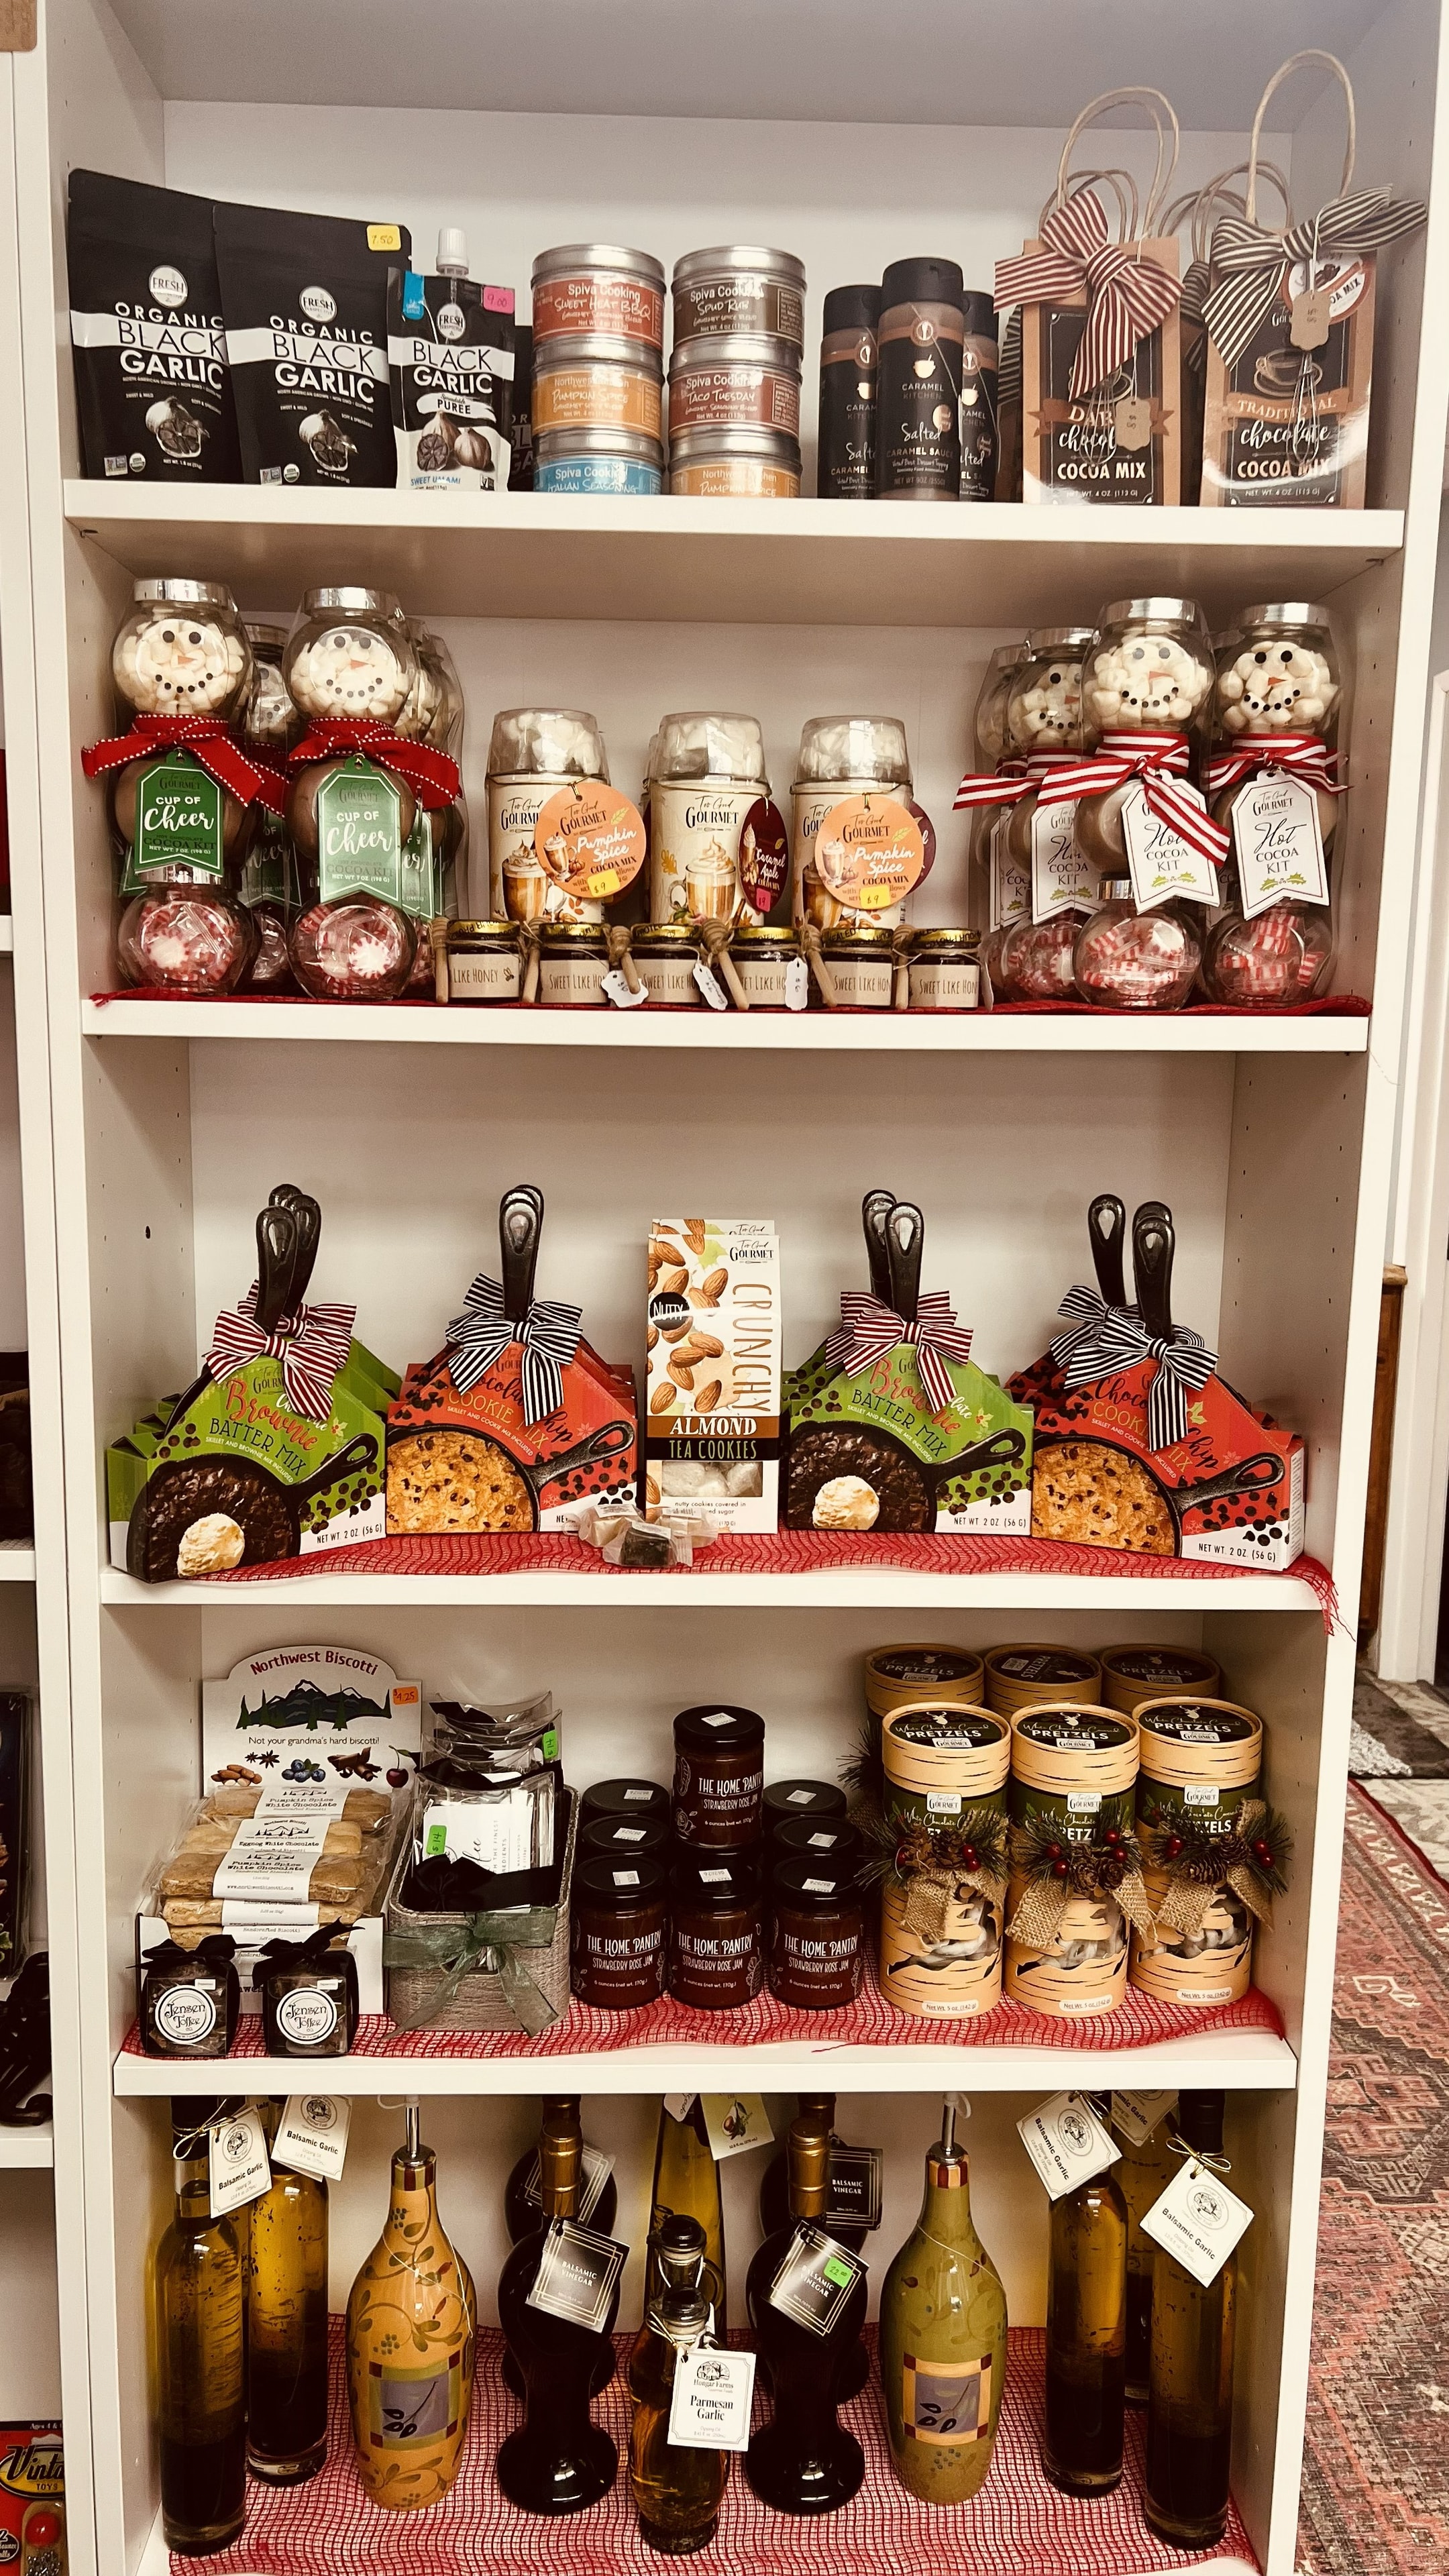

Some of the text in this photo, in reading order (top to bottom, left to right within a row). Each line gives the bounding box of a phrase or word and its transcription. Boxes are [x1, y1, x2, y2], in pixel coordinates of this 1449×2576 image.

[568, 283, 640, 302] Spiva Cooking
[690, 289, 714, 303] Spiva
[303, 297, 333, 311] FRESH
[621, 301, 650, 320] BBQ
[115, 302, 224, 329] ORGANIC
[439, 315, 463, 327] FRESH
[270, 316, 373, 344] ORGANIC
[118, 320, 227, 362] BLACK
[273, 333, 374, 376] BLACK
[413, 340, 492, 371] BLACK
[120, 350, 223, 389] GARLIC
[275, 363, 374, 403] GARLIC
[413, 366, 492, 394] GARLIC
[687, 376, 710, 390] Spiva
[902, 383, 944, 391] CARAMEL
[687, 389, 755, 405] TACO TUESDAY
[437, 400, 471, 415] PUREE
[1068, 405, 1113, 427] DAR
[1238, 398, 1336, 419] TRADITIOAL
[902, 422, 942, 441] Salted
[1240, 418, 1330, 449] chocolate
[886, 447, 954, 458] CARAMEL SAUCE
[1057, 462, 1146, 479] COCOA MIX
[1238, 460, 1291, 478] COCOA
[411, 476, 430, 486] SWEET
[160, 777, 201, 790] GOURMET
[156, 796, 201, 805] CUP OF
[1253, 798, 1293, 816] GOURMET
[144, 805, 214, 831] Cheer
[337, 811, 379, 822] CUP OF
[560, 810, 607, 835] GOURMET
[686, 806, 739, 828] GOURMET
[327, 822, 392, 856] Cheer
[578, 826, 637, 853] Pumpkin
[843, 824, 890, 843] GOURMET
[1254, 818, 1307, 854] Hot
[593, 845, 629, 865] Spice
[756, 847, 786, 867] Caramel
[854, 843, 915, 863] Pumpkin
[1146, 849, 1189, 860] COCOA
[1256, 847, 1299, 863] COCOA
[590, 855, 637, 873] COCOA MIX
[760, 863, 779, 879] Apple
[867, 862, 905, 879] Spice
[1158, 860, 1180, 871] KIT
[1267, 861, 1290, 874] KIT
[863, 877, 892, 885] COCOA
[453, 969, 499, 983] LIKE HONEY
[835, 975, 875, 991] SWEET LIKE
[920, 979, 960, 994] SWEET LIKE
[730, 1247, 774, 1262] GOURMET
[653, 1301, 684, 1320] NUTTY
[732, 1283, 773, 1411] CRUNCHY
[225, 1377, 318, 1452] Brownie
[448, 1389, 515, 1424] COOKIE
[447, 1405, 534, 1458] SKILLET AND COOKIE MIX INCLUDED
[670, 1417, 757, 1436] ALMOND
[851, 1389, 948, 1458] BATTER MIX
[210, 1417, 307, 1477] BATTER MIX
[669, 1440, 757, 1460] TEA COOKIES
[1181, 1427, 1219, 1469] Chip
[205, 1436, 294, 1484] SKILLET AND BROWNIE MIX INCLUDED
[1199, 1543, 1211, 1552] NET
[1252, 1550, 1264, 1560] (56
[1267, 1552, 1275, 1562] G)
[250, 1650, 379, 1676] Northwest Biscotti
[885, 1664, 955, 1676] PRETZELS
[906, 1730, 981, 1738] PRETZELS
[1032, 1729, 1109, 1740] PRETZELS
[1155, 1722, 1232, 1733] PRETZELS
[248, 1736, 380, 1747] Not your grandma's hard biscotti!
[929, 1800, 959, 1810] GOURMET
[923, 1810, 956, 1827] Chocolate
[587, 1929, 661, 1957] THE HOME PANTRY
[678, 1932, 753, 1956] THE HOME PANTRY
[593, 1954, 653, 1970] STRAWBERRY ROSE JAM
[683, 1955, 743, 1971] STRAWBERRY ROSE JAM
[164, 2001, 206, 2018] Jensen
[173, 2015, 201, 2029] Toffee
[287, 2130, 339, 2155] Balsamic Garlic
[1034, 2117, 1056, 2155] Balsamic
[1054, 2155, 1069, 2181] Garlic
[219, 2172, 246, 2190] Balsamic
[247, 2162, 264, 2176] Garlic
[832, 2179, 863, 2188] BALSAMIC
[833, 2186, 861, 2194] VINEGAR
[1162, 2208, 1194, 2240] Balsamic
[1195, 2237, 1216, 2260] Garlic
[561, 2269, 594, 2287] VINEGAR
[562, 2261, 598, 2279] BALSAMIC
[690, 2395, 733, 2410] Parmesan
[697, 2408, 724, 2420] Garlic
